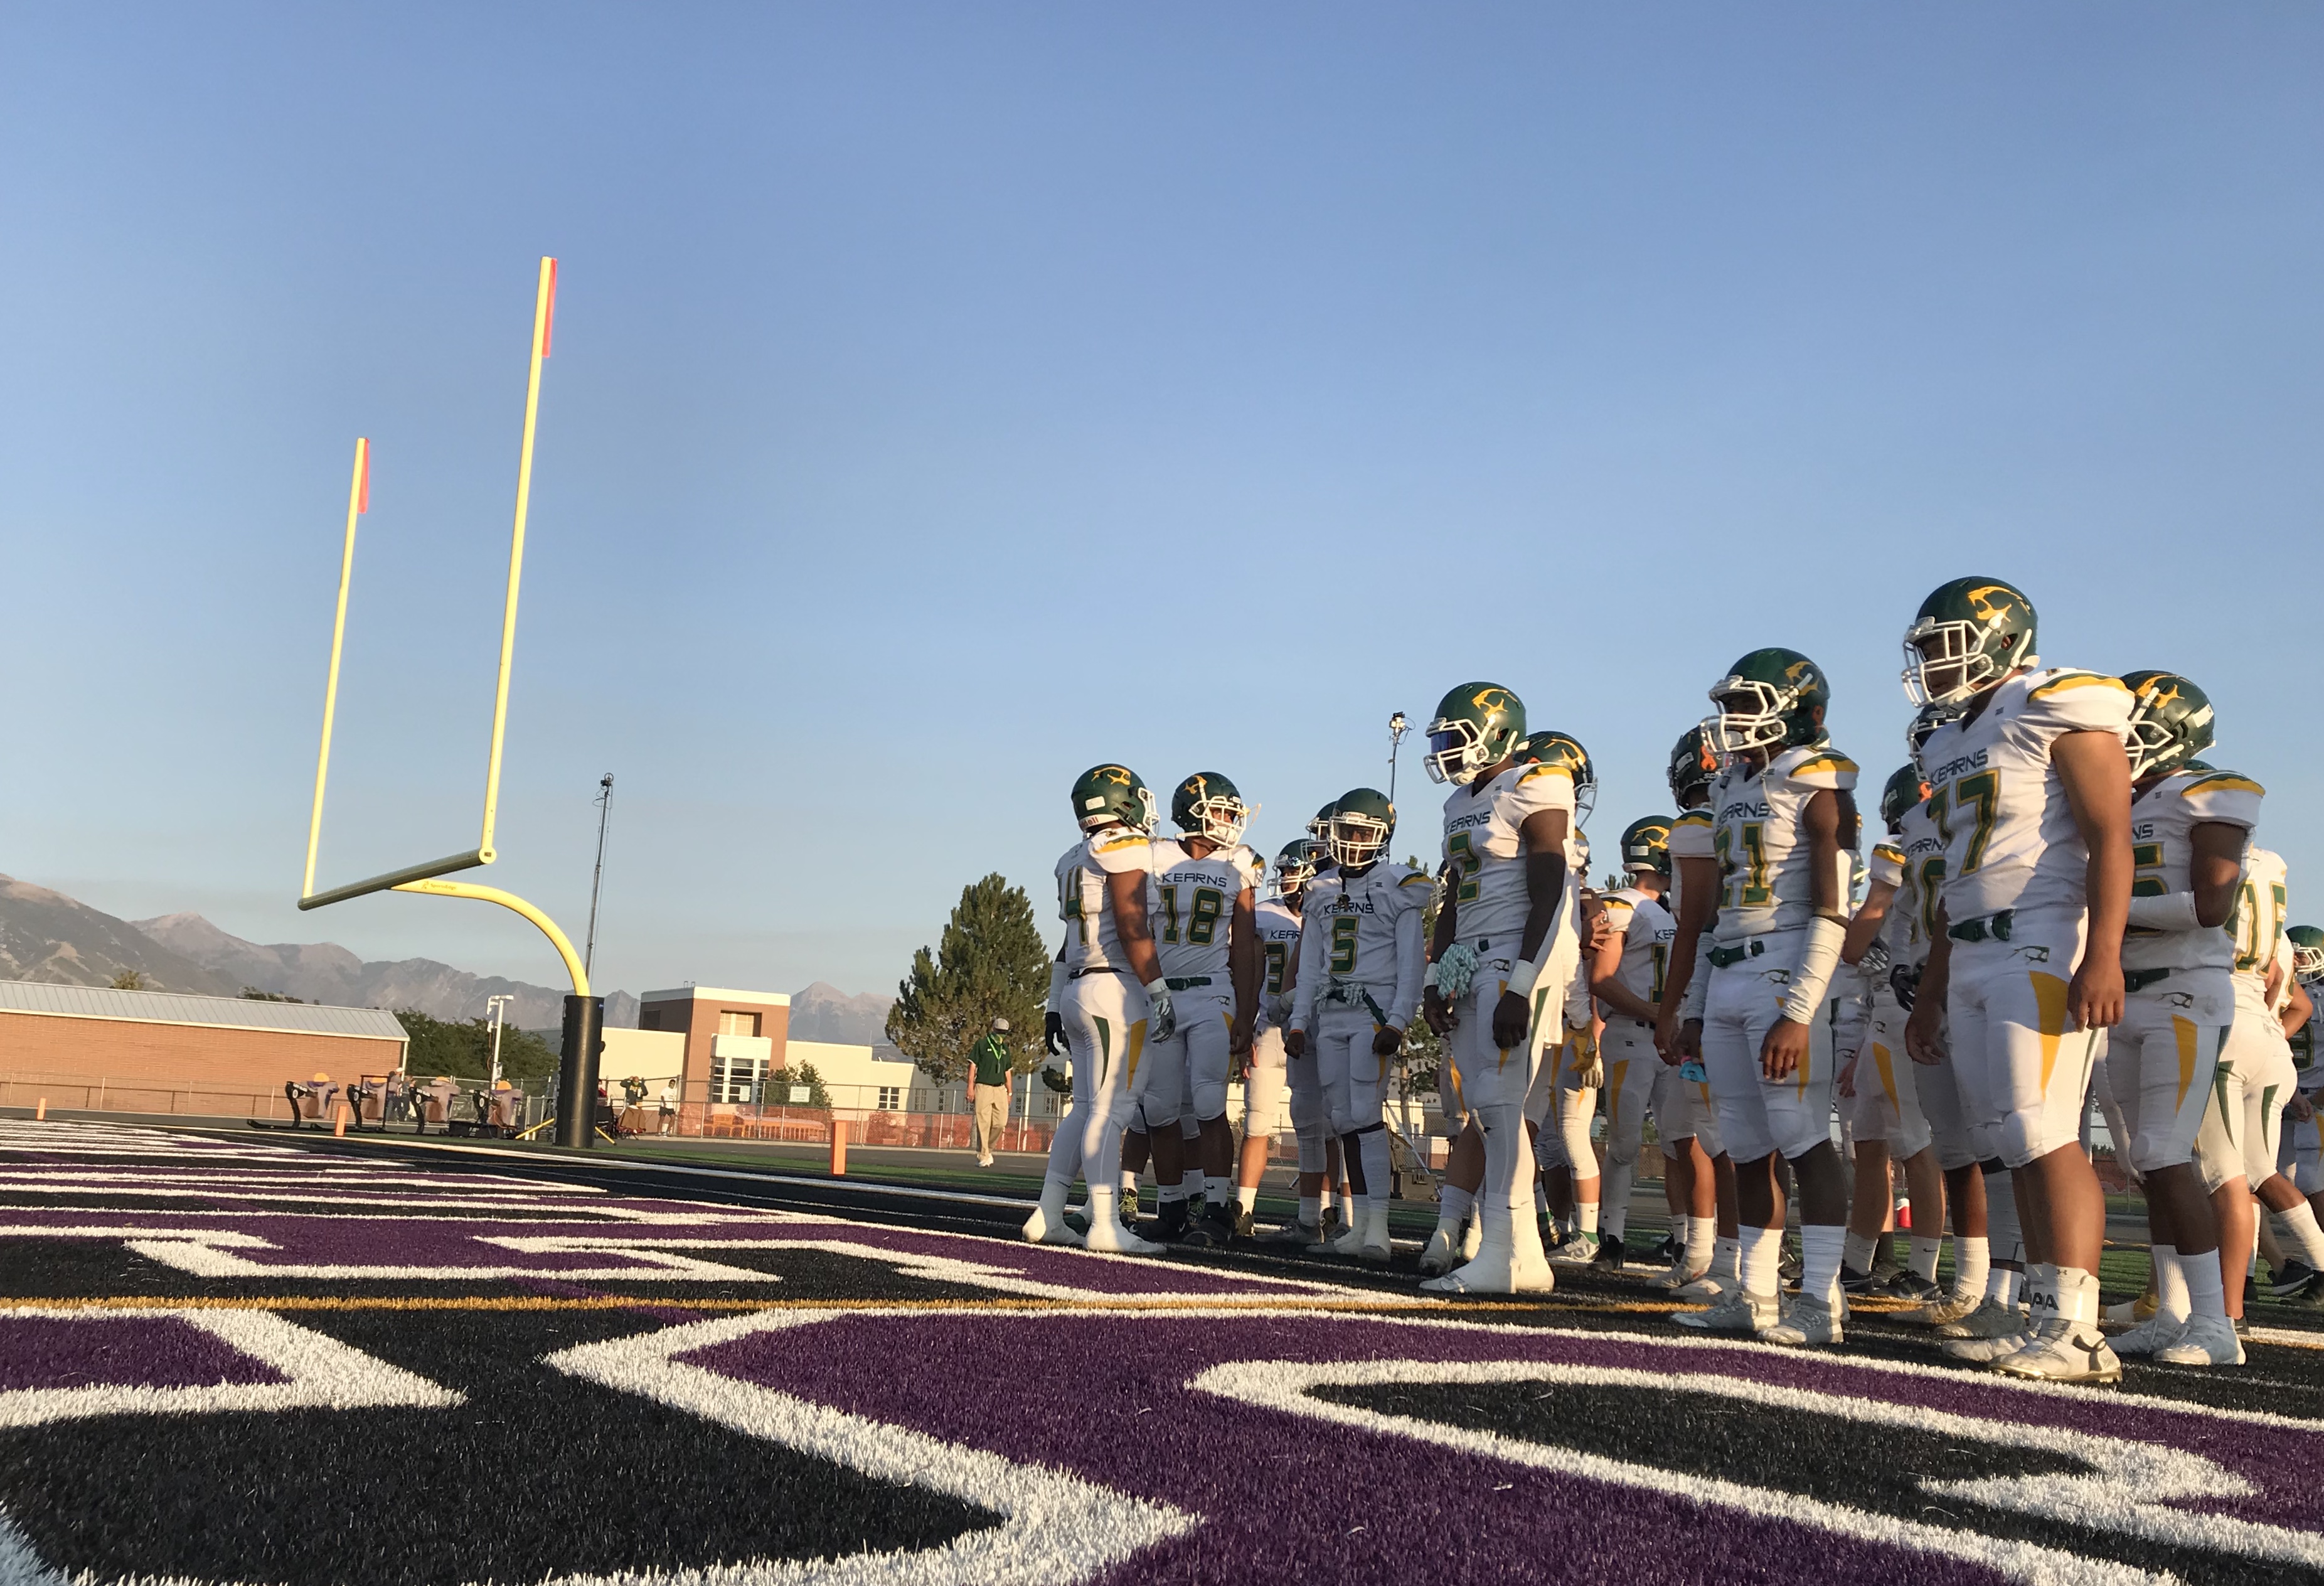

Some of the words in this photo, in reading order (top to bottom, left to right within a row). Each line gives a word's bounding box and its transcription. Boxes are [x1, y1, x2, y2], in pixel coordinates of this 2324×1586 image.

[1931, 748, 1988, 785] KEARNS
[1162, 873, 1227, 887] KEARNS
[1447, 829, 1482, 904] 2
[1160, 884, 1224, 947] 18
[1328, 914, 1361, 976] 5
[1263, 941, 1288, 995] 3
[1649, 942, 1668, 1005] 1
